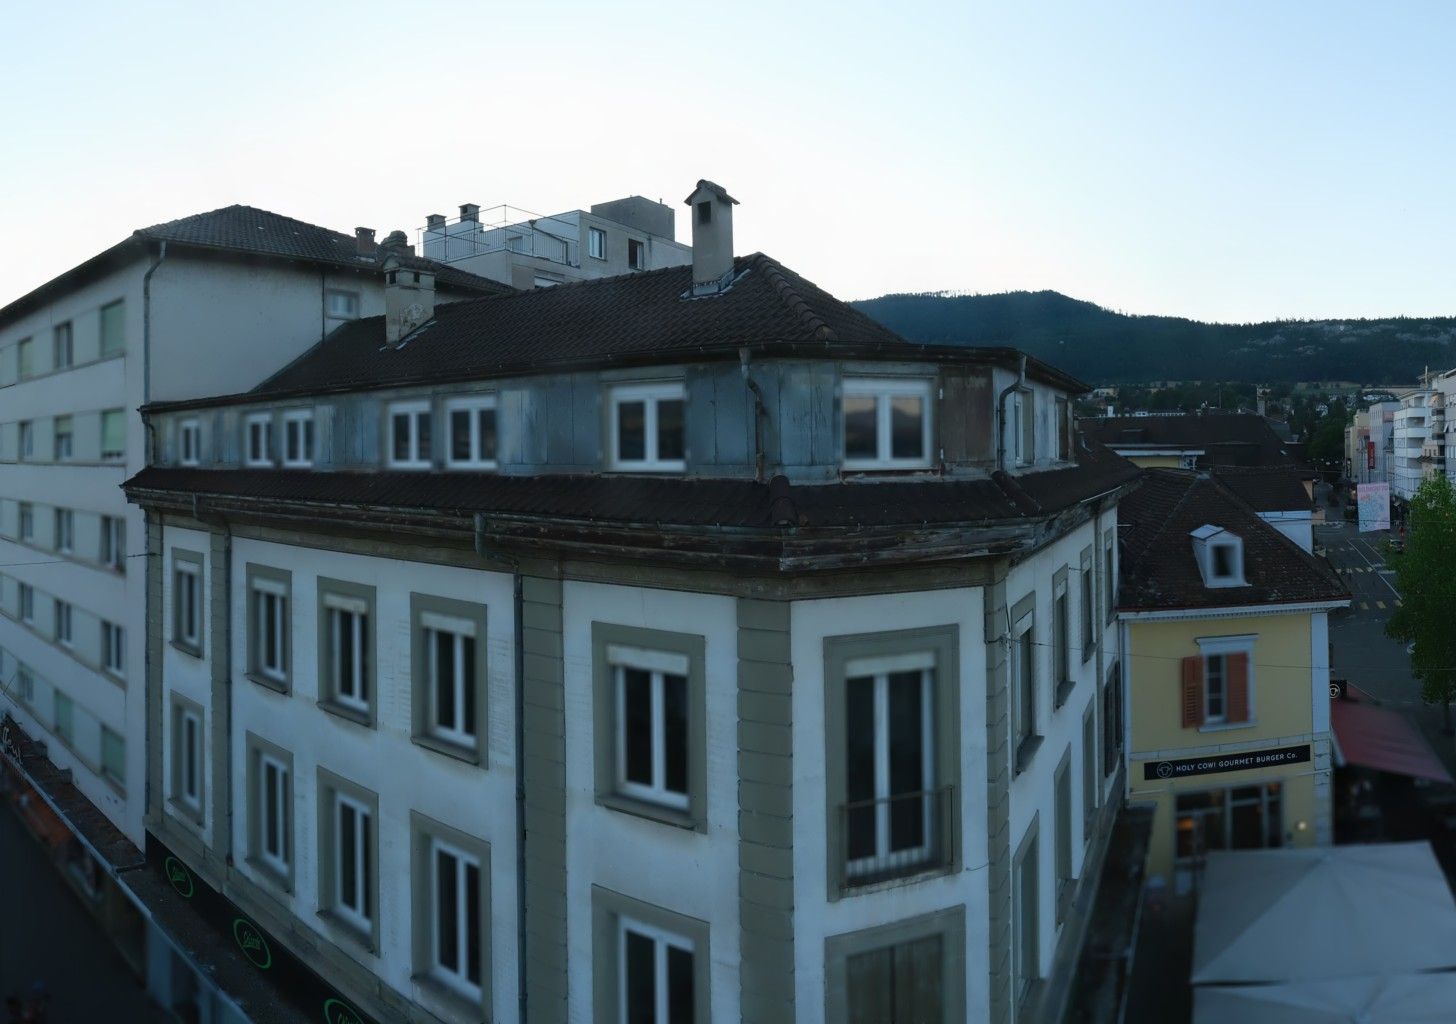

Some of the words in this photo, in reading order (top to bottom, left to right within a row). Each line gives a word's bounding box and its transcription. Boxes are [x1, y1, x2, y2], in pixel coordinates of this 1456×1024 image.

[1176, 764, 1195, 772] HOLY
[1218, 758, 1253, 768] GOURMET
[1256, 753, 1284, 763] BURGER
